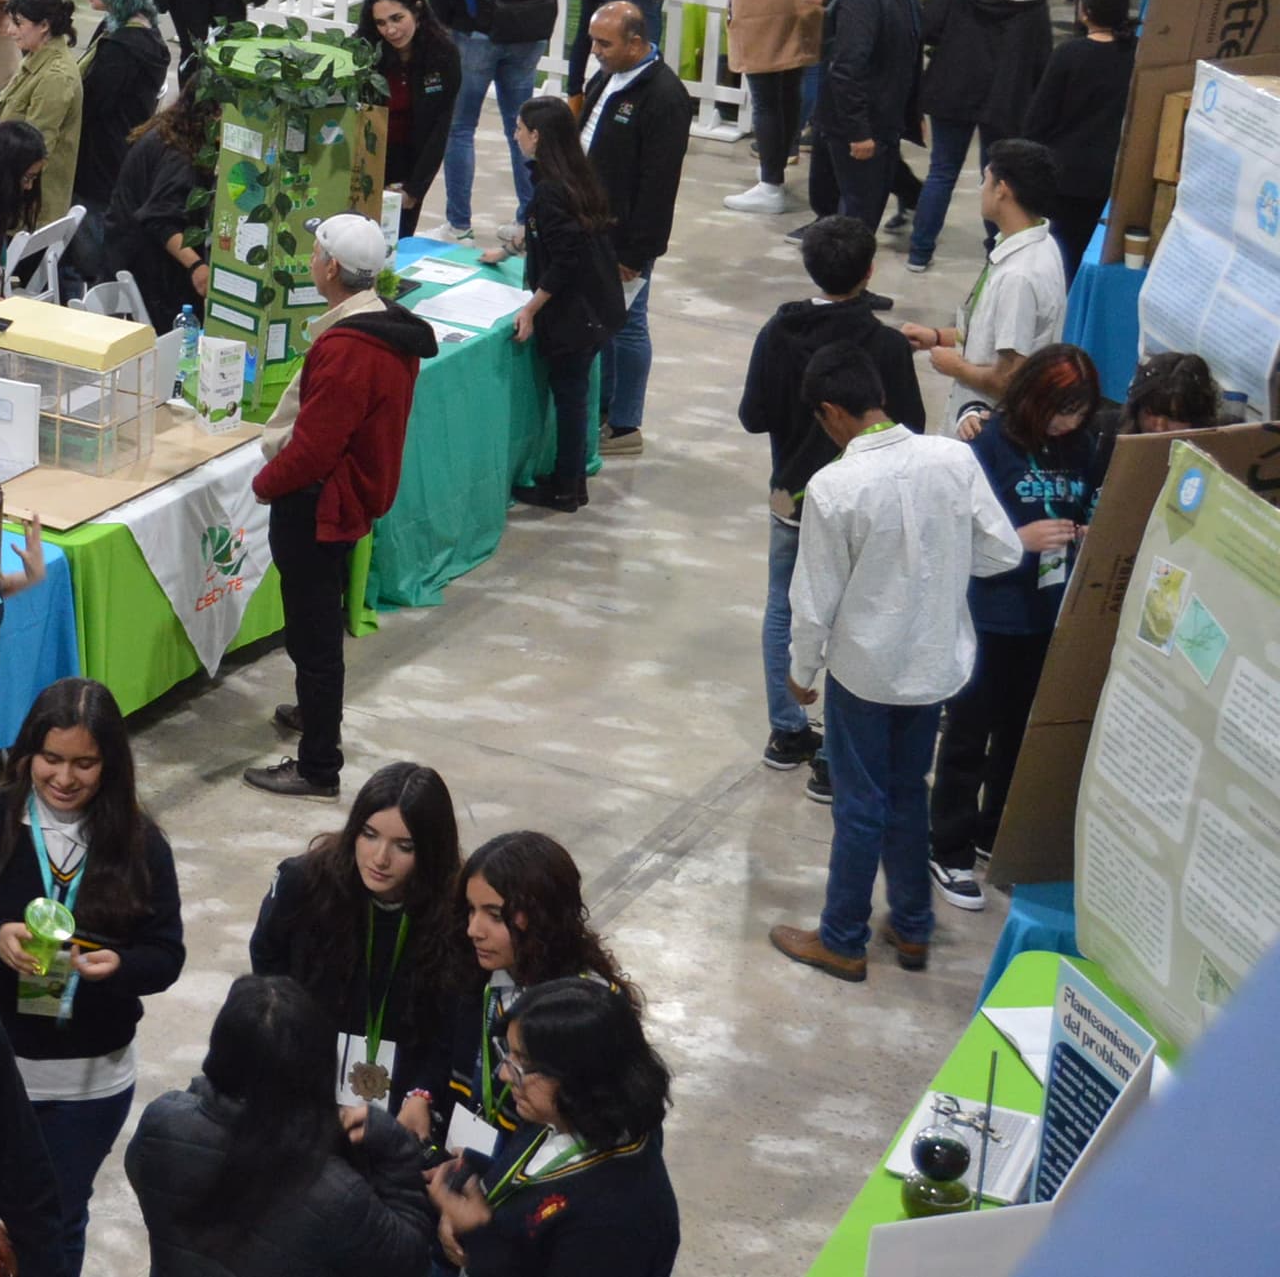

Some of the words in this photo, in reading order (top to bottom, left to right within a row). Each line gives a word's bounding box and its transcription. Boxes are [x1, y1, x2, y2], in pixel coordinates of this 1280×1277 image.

[1015, 480, 1084, 497] CESUN
[195, 576, 244, 612] CECTE
[1063, 1014, 1081, 1038] del
[1082, 1032, 1132, 1084] problem
[1064, 986, 1141, 1068] Planteamiento
